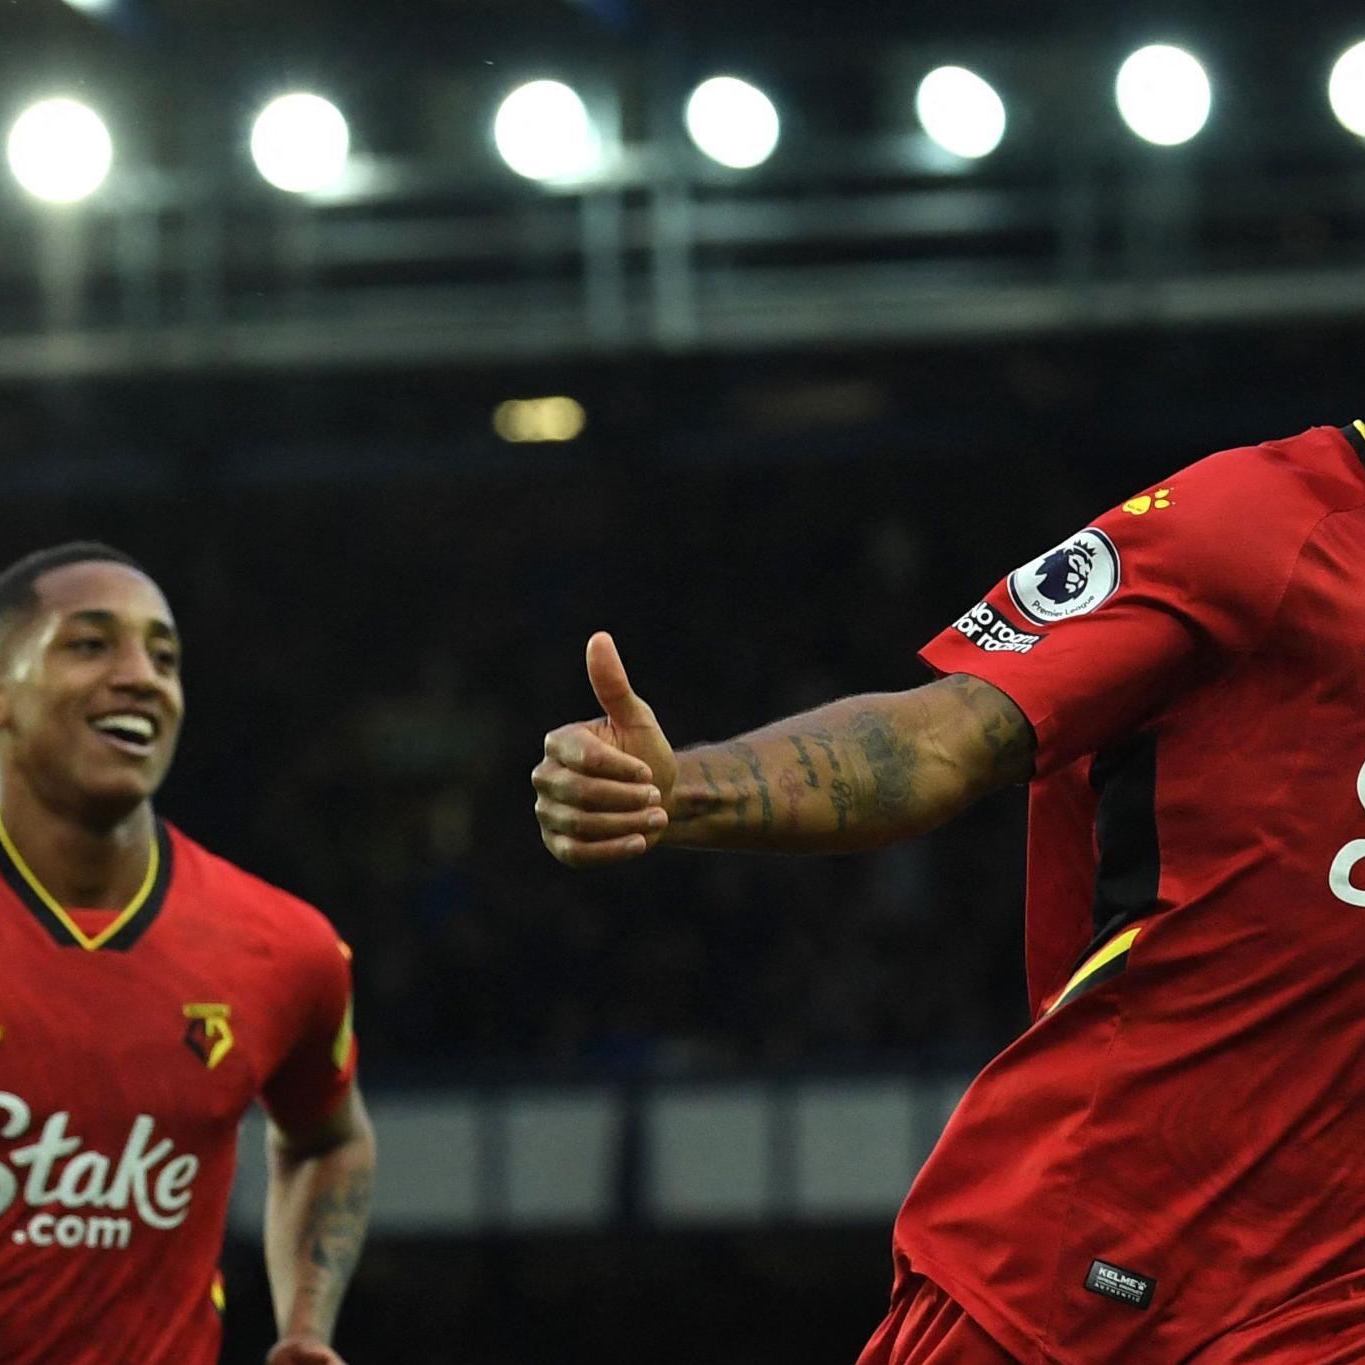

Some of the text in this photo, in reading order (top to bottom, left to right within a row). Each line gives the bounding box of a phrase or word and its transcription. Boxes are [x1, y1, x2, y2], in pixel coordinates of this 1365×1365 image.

[1032, 600, 1062, 616] Premier
[990, 620, 1040, 645] room
[12, 1213, 132, 1249] .com
[1098, 1266, 1137, 1289] KELME
